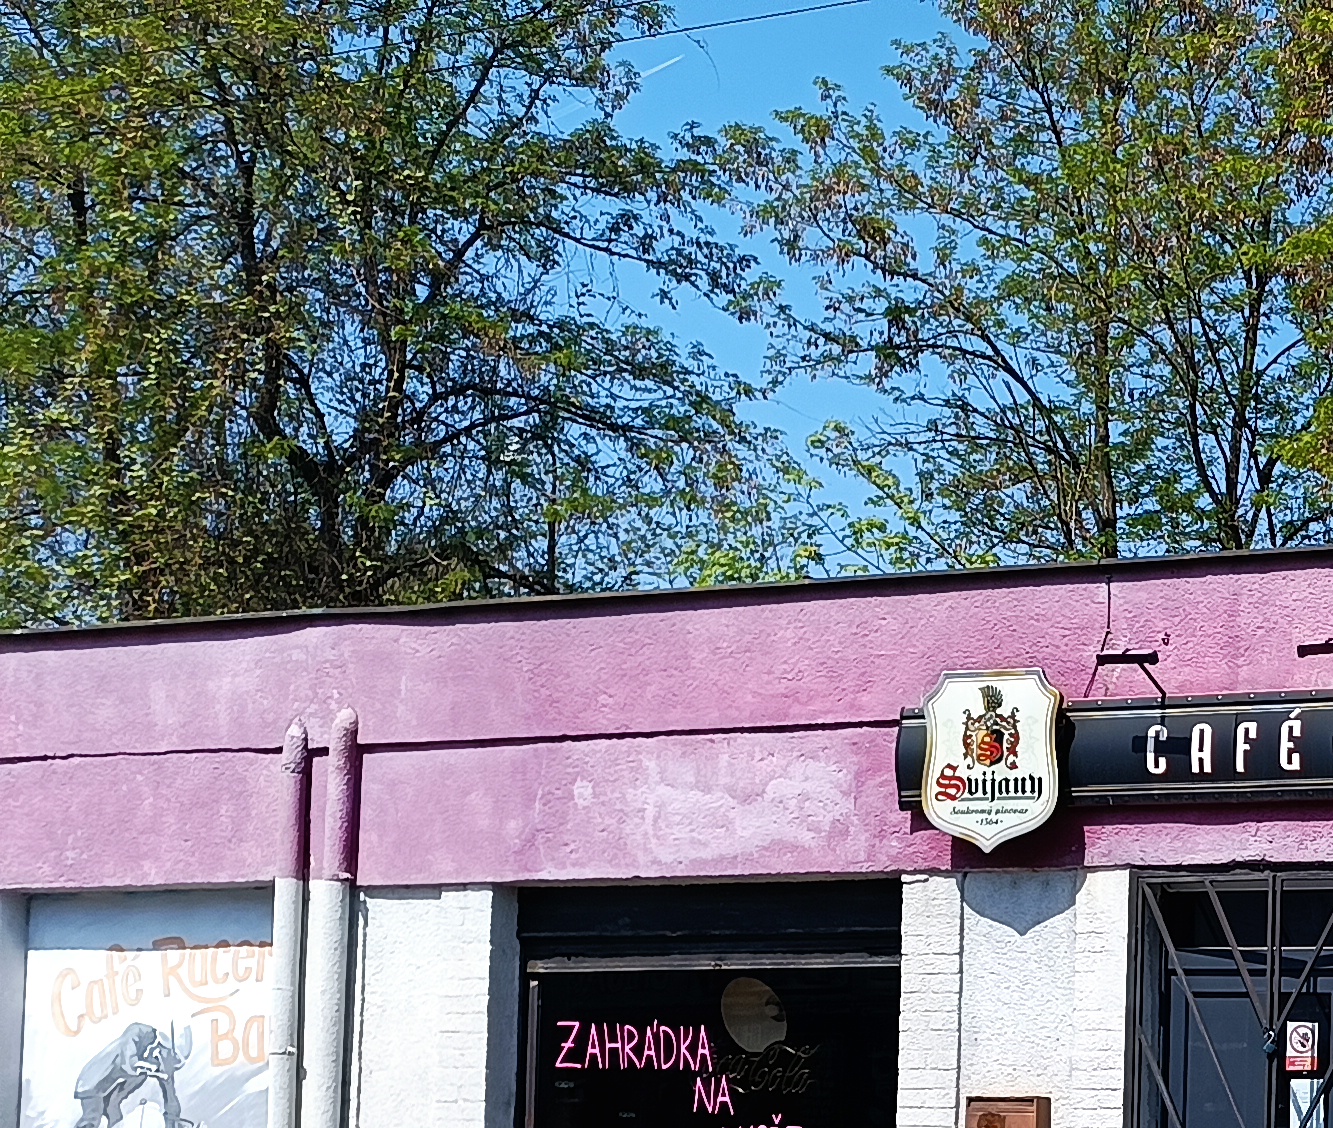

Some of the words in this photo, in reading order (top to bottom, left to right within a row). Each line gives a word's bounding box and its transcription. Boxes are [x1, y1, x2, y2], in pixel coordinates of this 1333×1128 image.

[1146, 709, 1301, 775] CAFÉ
[934, 763, 1043, 803] Svijany
[51, 942, 143, 1037] Café
[152, 936, 272, 1004] Racer
[190, 1004, 270, 1067] Ba
[555, 1019, 713, 1072] ZAHRÁDKA
[693, 1074, 734, 1116] NA
